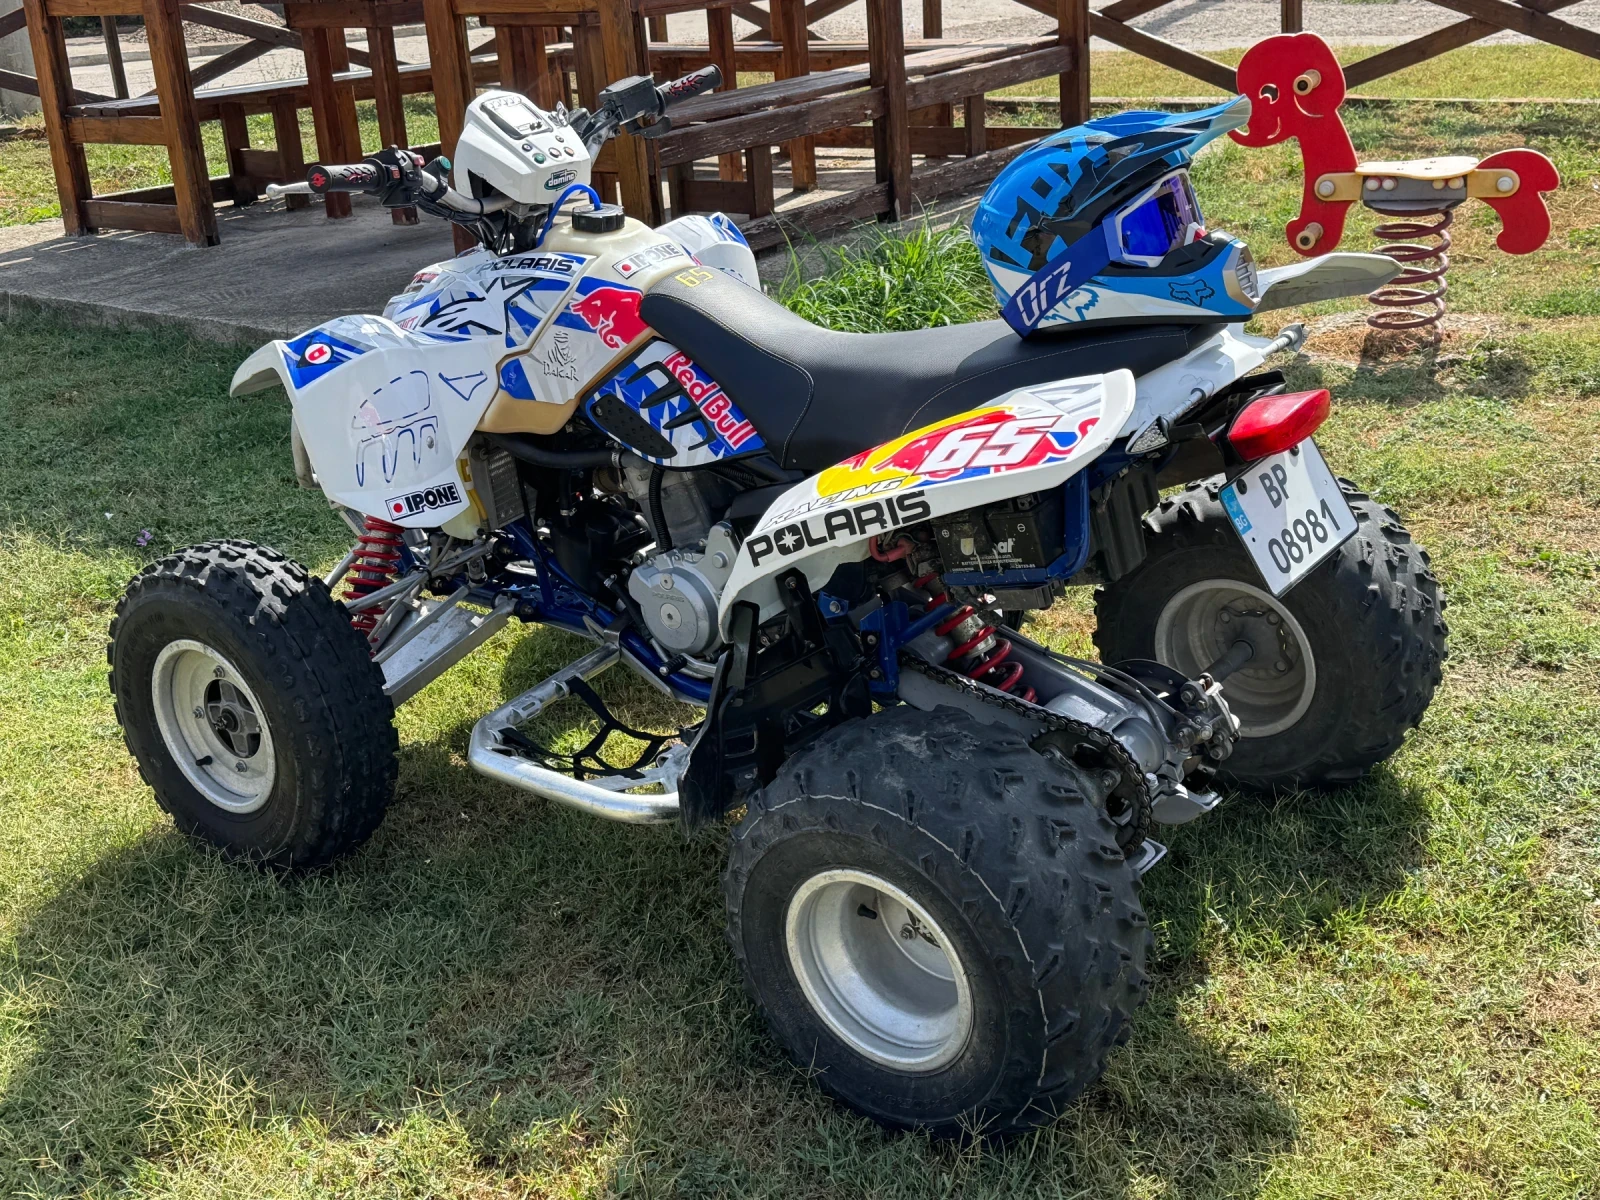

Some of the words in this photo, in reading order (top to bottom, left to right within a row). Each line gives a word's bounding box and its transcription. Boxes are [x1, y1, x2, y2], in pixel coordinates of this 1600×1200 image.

[548, 171, 575, 187] domino
[476, 257, 576, 275] POLARIS
[629, 244, 679, 268] IPONE
[675, 267, 714, 288] 65
[662, 349, 720, 406] Red
[699, 389, 758, 451] Bull
[912, 415, 1064, 476] 65
[405, 485, 459, 513] IPONE
[762, 475, 909, 529] RACING
[1258, 463, 1290, 509] BP
[746, 489, 931, 568] POLARIS
[1234, 514, 1248, 530] BG
[1268, 498, 1341, 574] 08981
